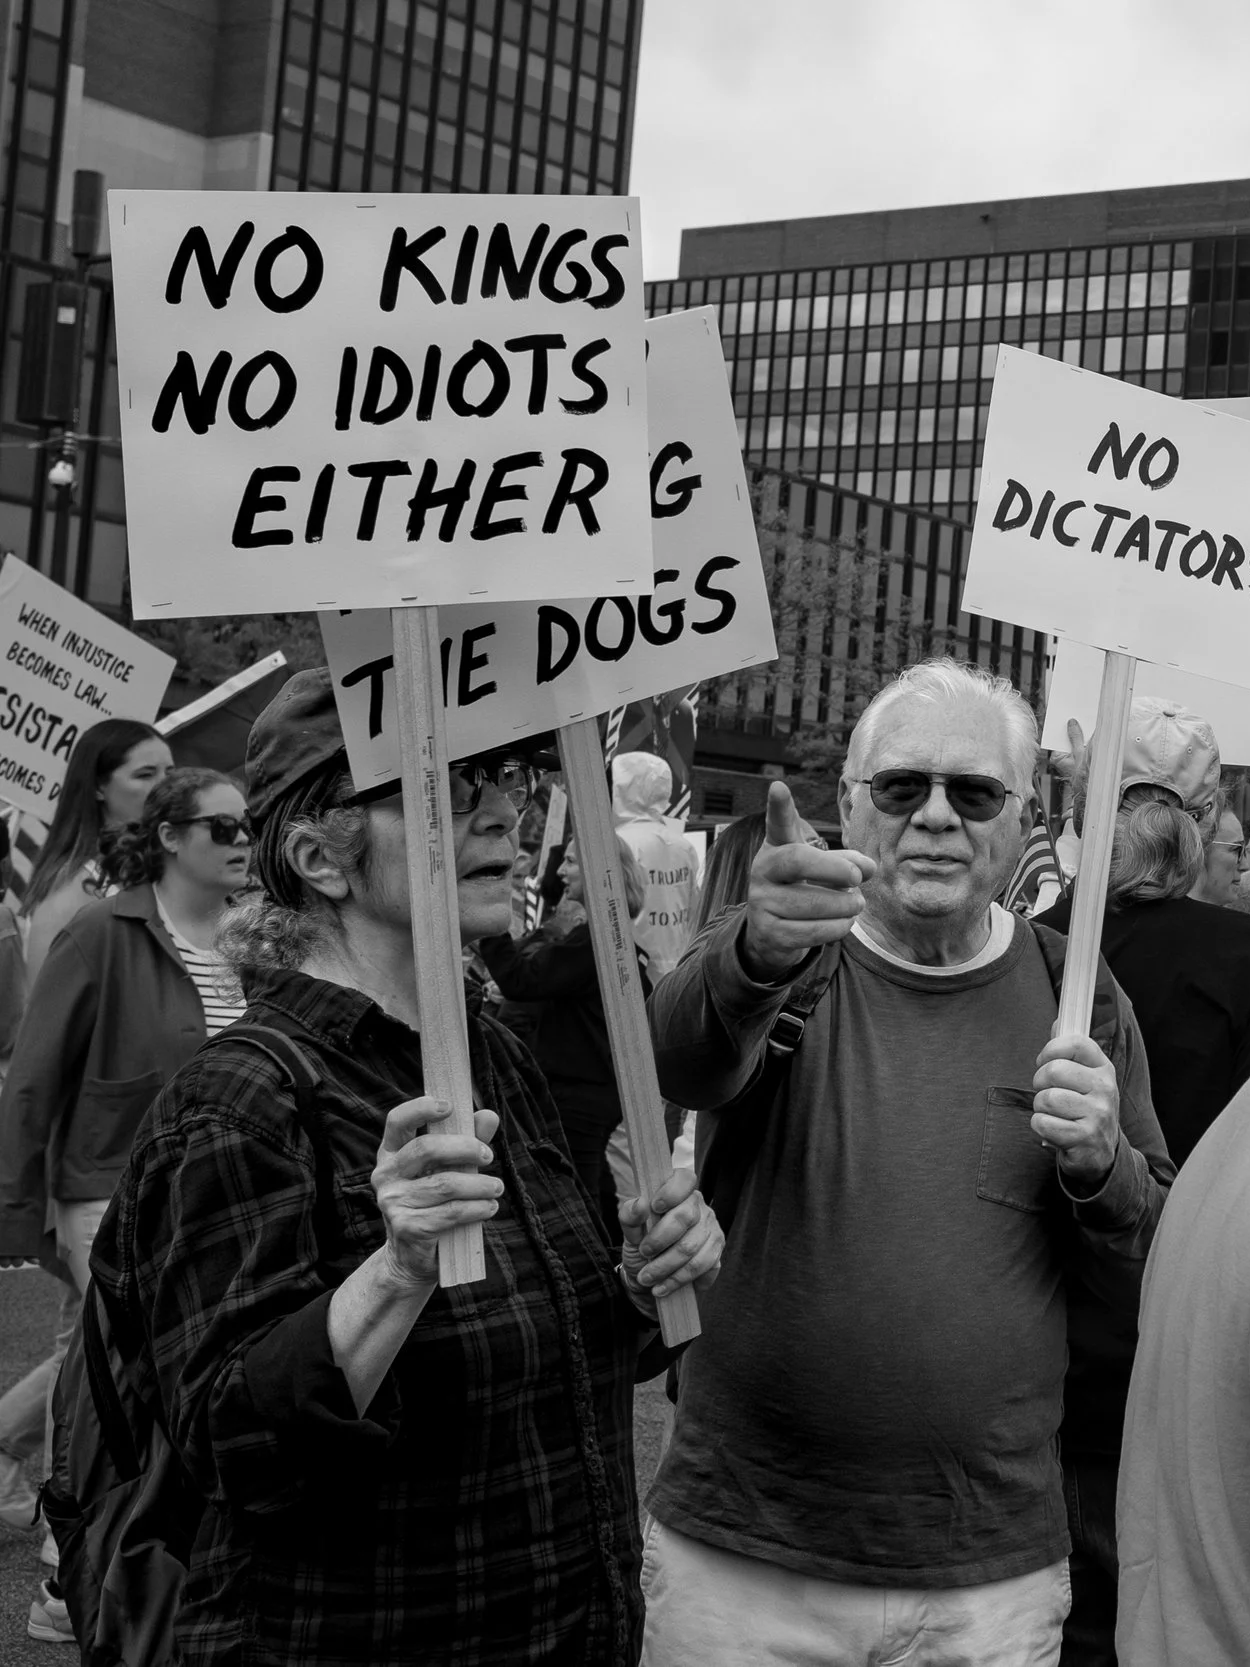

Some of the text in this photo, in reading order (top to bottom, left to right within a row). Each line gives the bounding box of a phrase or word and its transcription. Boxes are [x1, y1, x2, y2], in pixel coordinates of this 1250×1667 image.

[164, 221, 630, 314] NO KINGS
[152, 333, 612, 434] NO IDIOTS
[231, 447, 610, 549] EITHER
[1087, 421, 1180, 491] NO
[18, 603, 134, 683] WHEN INJUSTICE
[538, 556, 741, 686] DOGS
[6, 641, 112, 716] BECOMES LAW...
[649, 866, 689, 885] TRUMP
